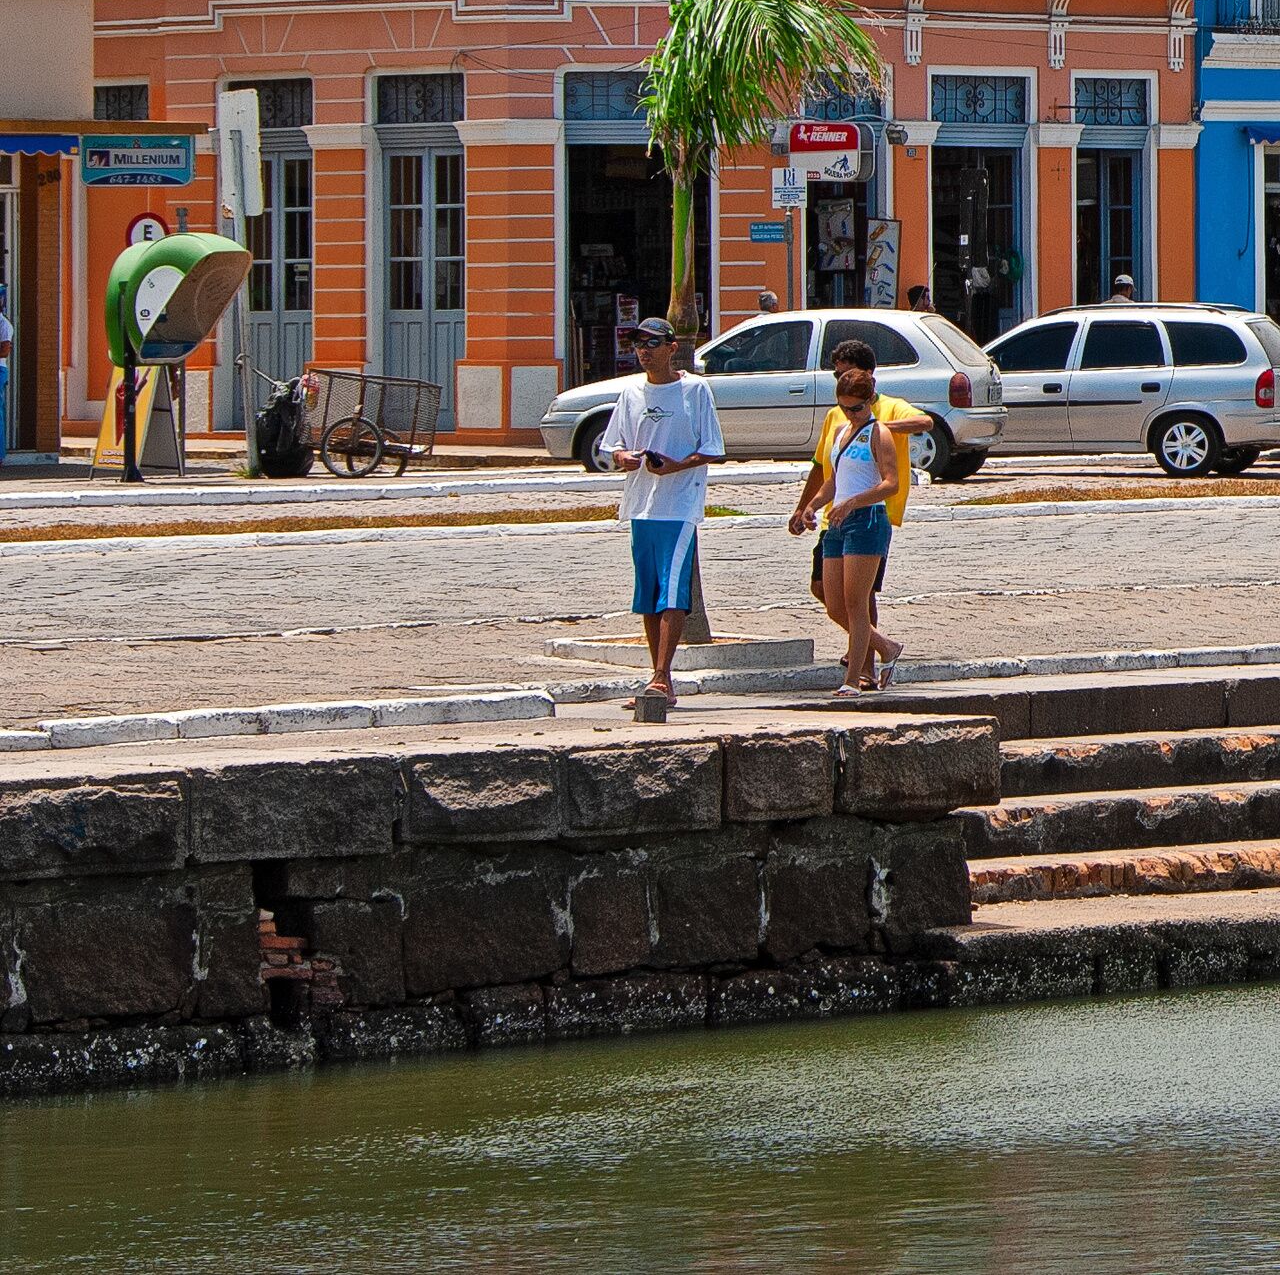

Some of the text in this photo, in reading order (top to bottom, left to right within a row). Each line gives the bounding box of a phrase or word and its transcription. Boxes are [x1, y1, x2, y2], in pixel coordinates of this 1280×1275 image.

[809, 132, 848, 142] RENNER
[113, 153, 180, 165] MILLENIUM
[143, 224, 154, 241] E
